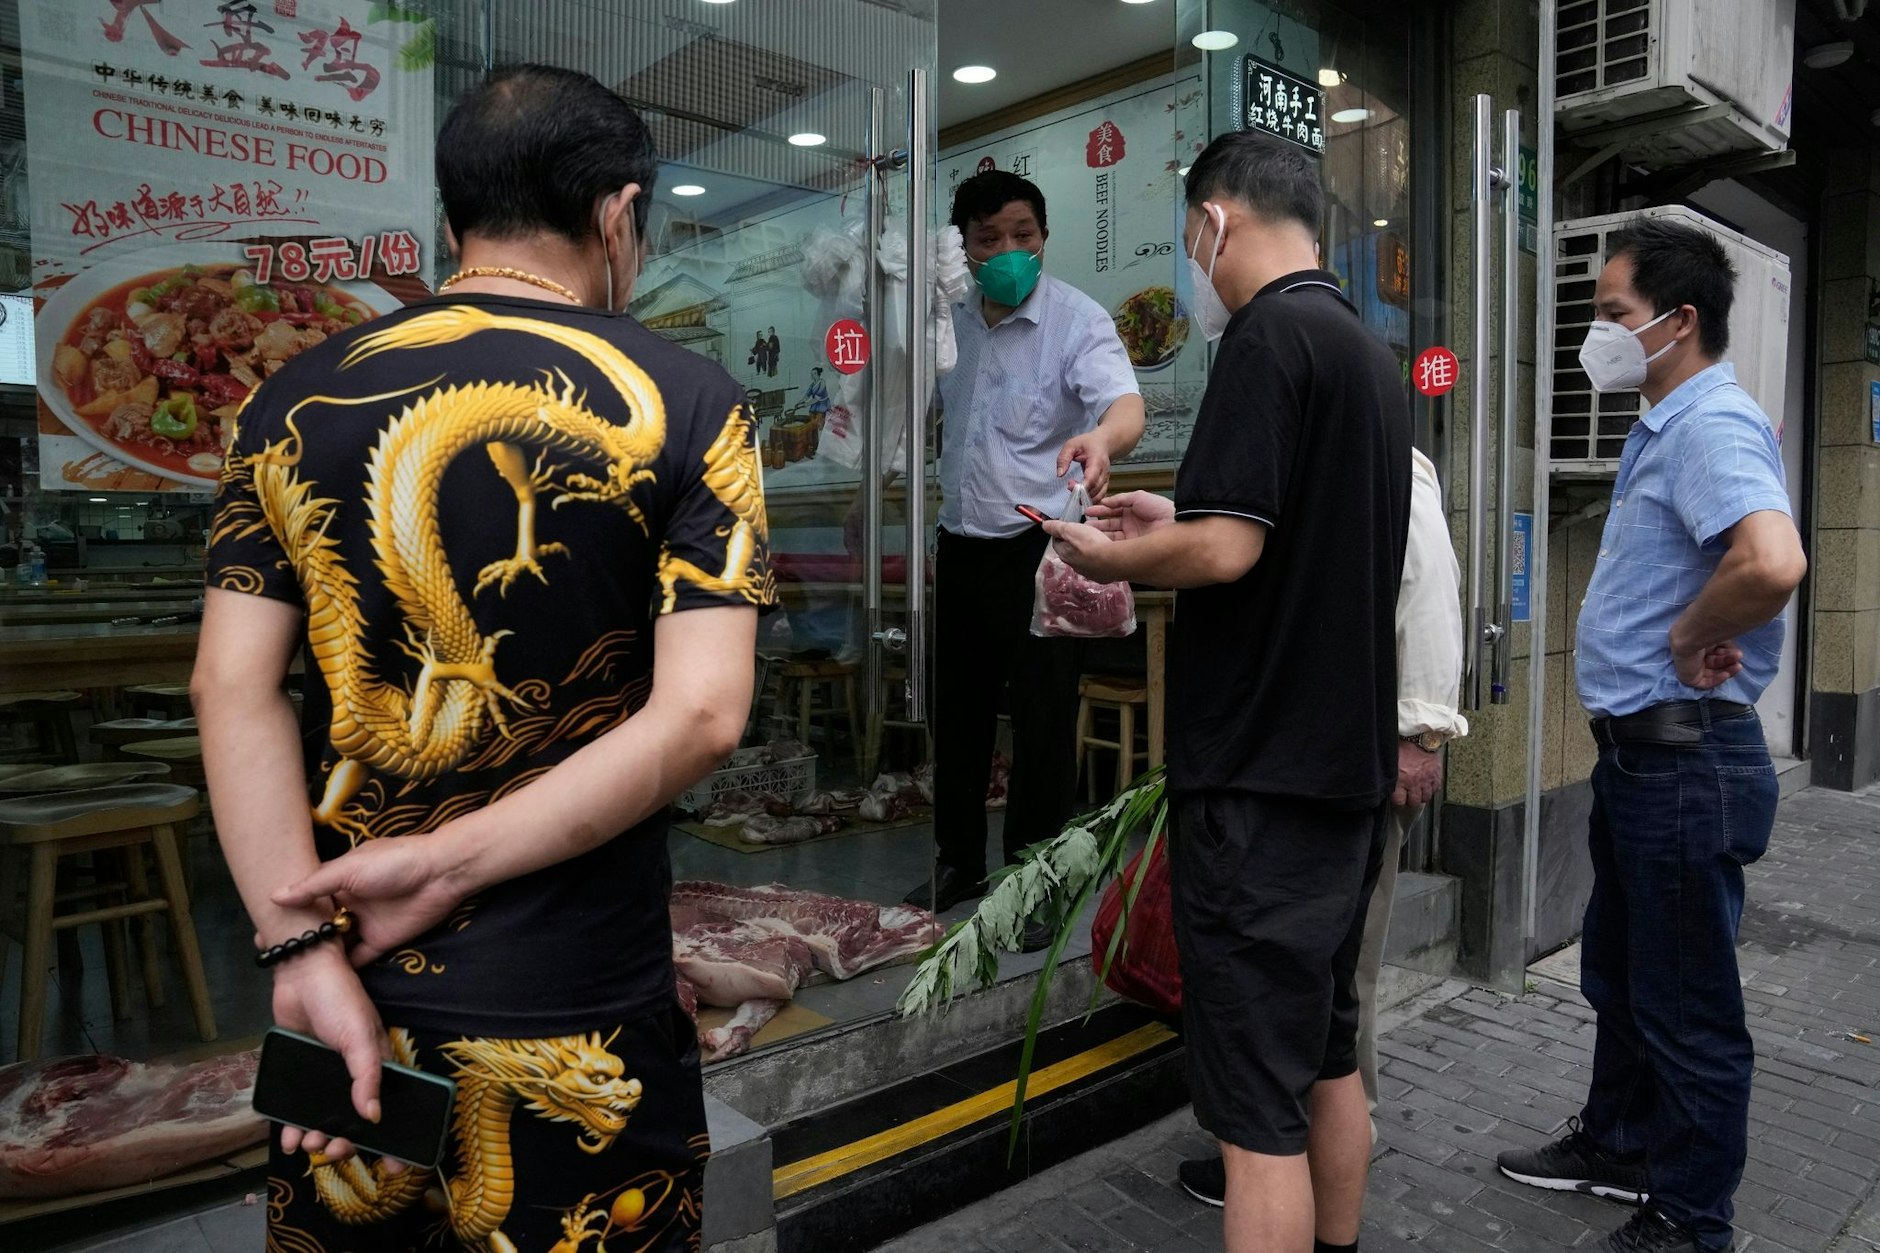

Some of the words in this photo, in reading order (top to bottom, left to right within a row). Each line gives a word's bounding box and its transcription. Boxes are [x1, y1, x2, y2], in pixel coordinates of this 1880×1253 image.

[92, 89, 127, 103] CHINESE
[128, 97, 176, 113] TRADITIONAL
[178, 105, 213, 119] DELICACY
[251, 120, 270, 131] LEAD
[276, 126, 304, 137] PERSON
[305, 130, 314, 140] TO
[314, 133, 344, 144] ENDLESS
[345, 139, 388, 153] AFTERTASTES
[94, 62, 245, 109] 中华传统美食
[258, 96, 386, 137] 美味回味无穷
[1259, 72, 1317, 121] 河南手工
[92, 108, 277, 167] CHINESE
[286, 142, 388, 184] FOOD
[1096, 123, 1113, 165] 美食
[1250, 101, 1324, 146] 红烧牛肉面
[1096, 172, 1109, 205] BEEF
[244, 230, 420, 285] 78元/份
[1096, 208, 1109, 273] NOODLES
[833, 328, 865, 365] 拉
[1420, 355, 1452, 389] 推
